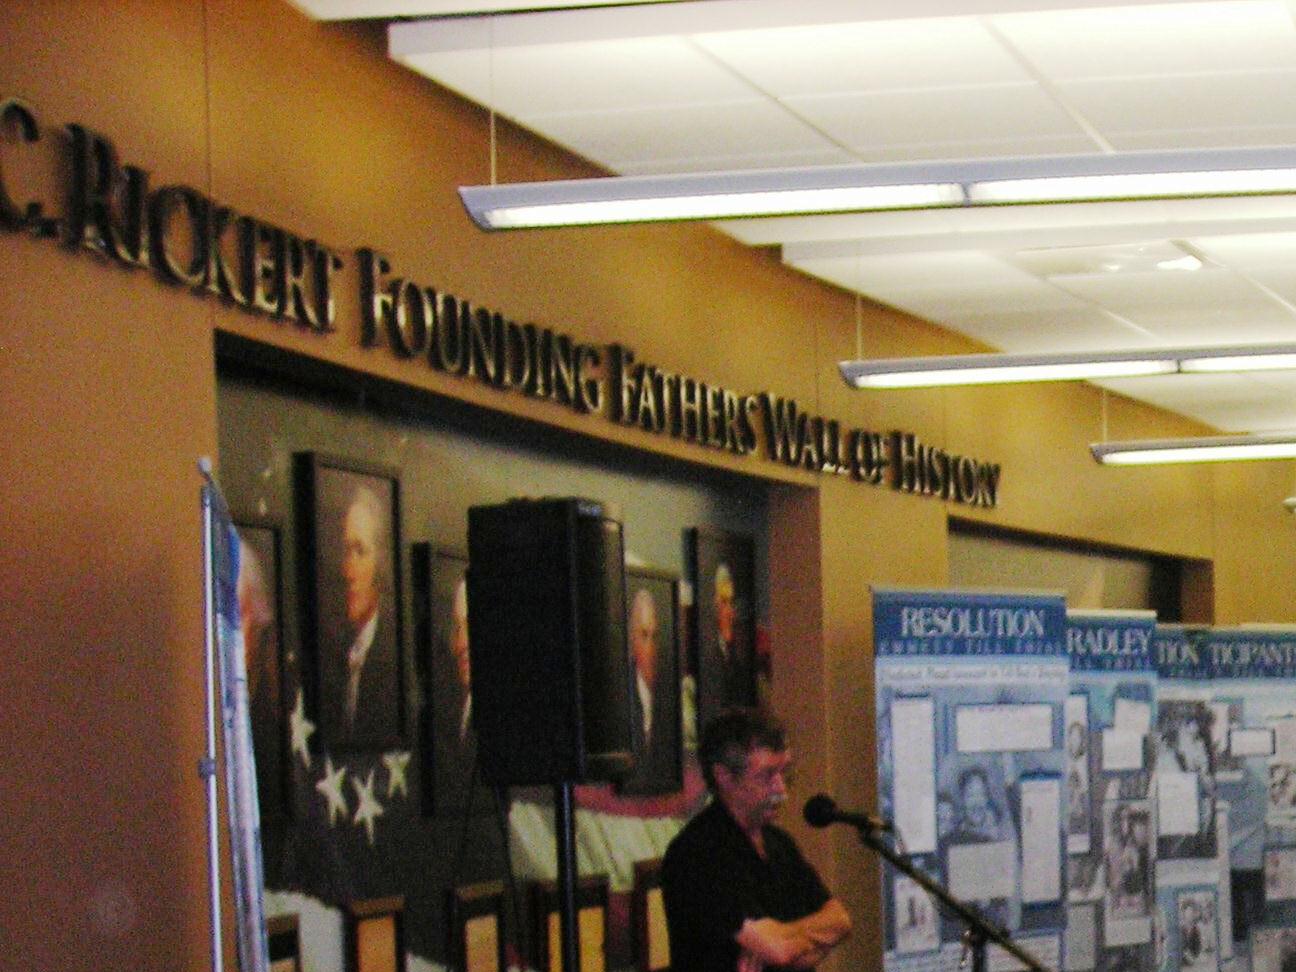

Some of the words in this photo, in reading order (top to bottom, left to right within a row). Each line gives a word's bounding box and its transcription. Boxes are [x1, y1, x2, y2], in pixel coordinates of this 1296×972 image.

[355, 248, 604, 414] FOUNDING
[757, 390, 850, 475] WALL
[846, 427, 889, 486] OF
[888, 429, 1000, 509] HISTORY
[900, 606, 1046, 638] RESOLUTION
